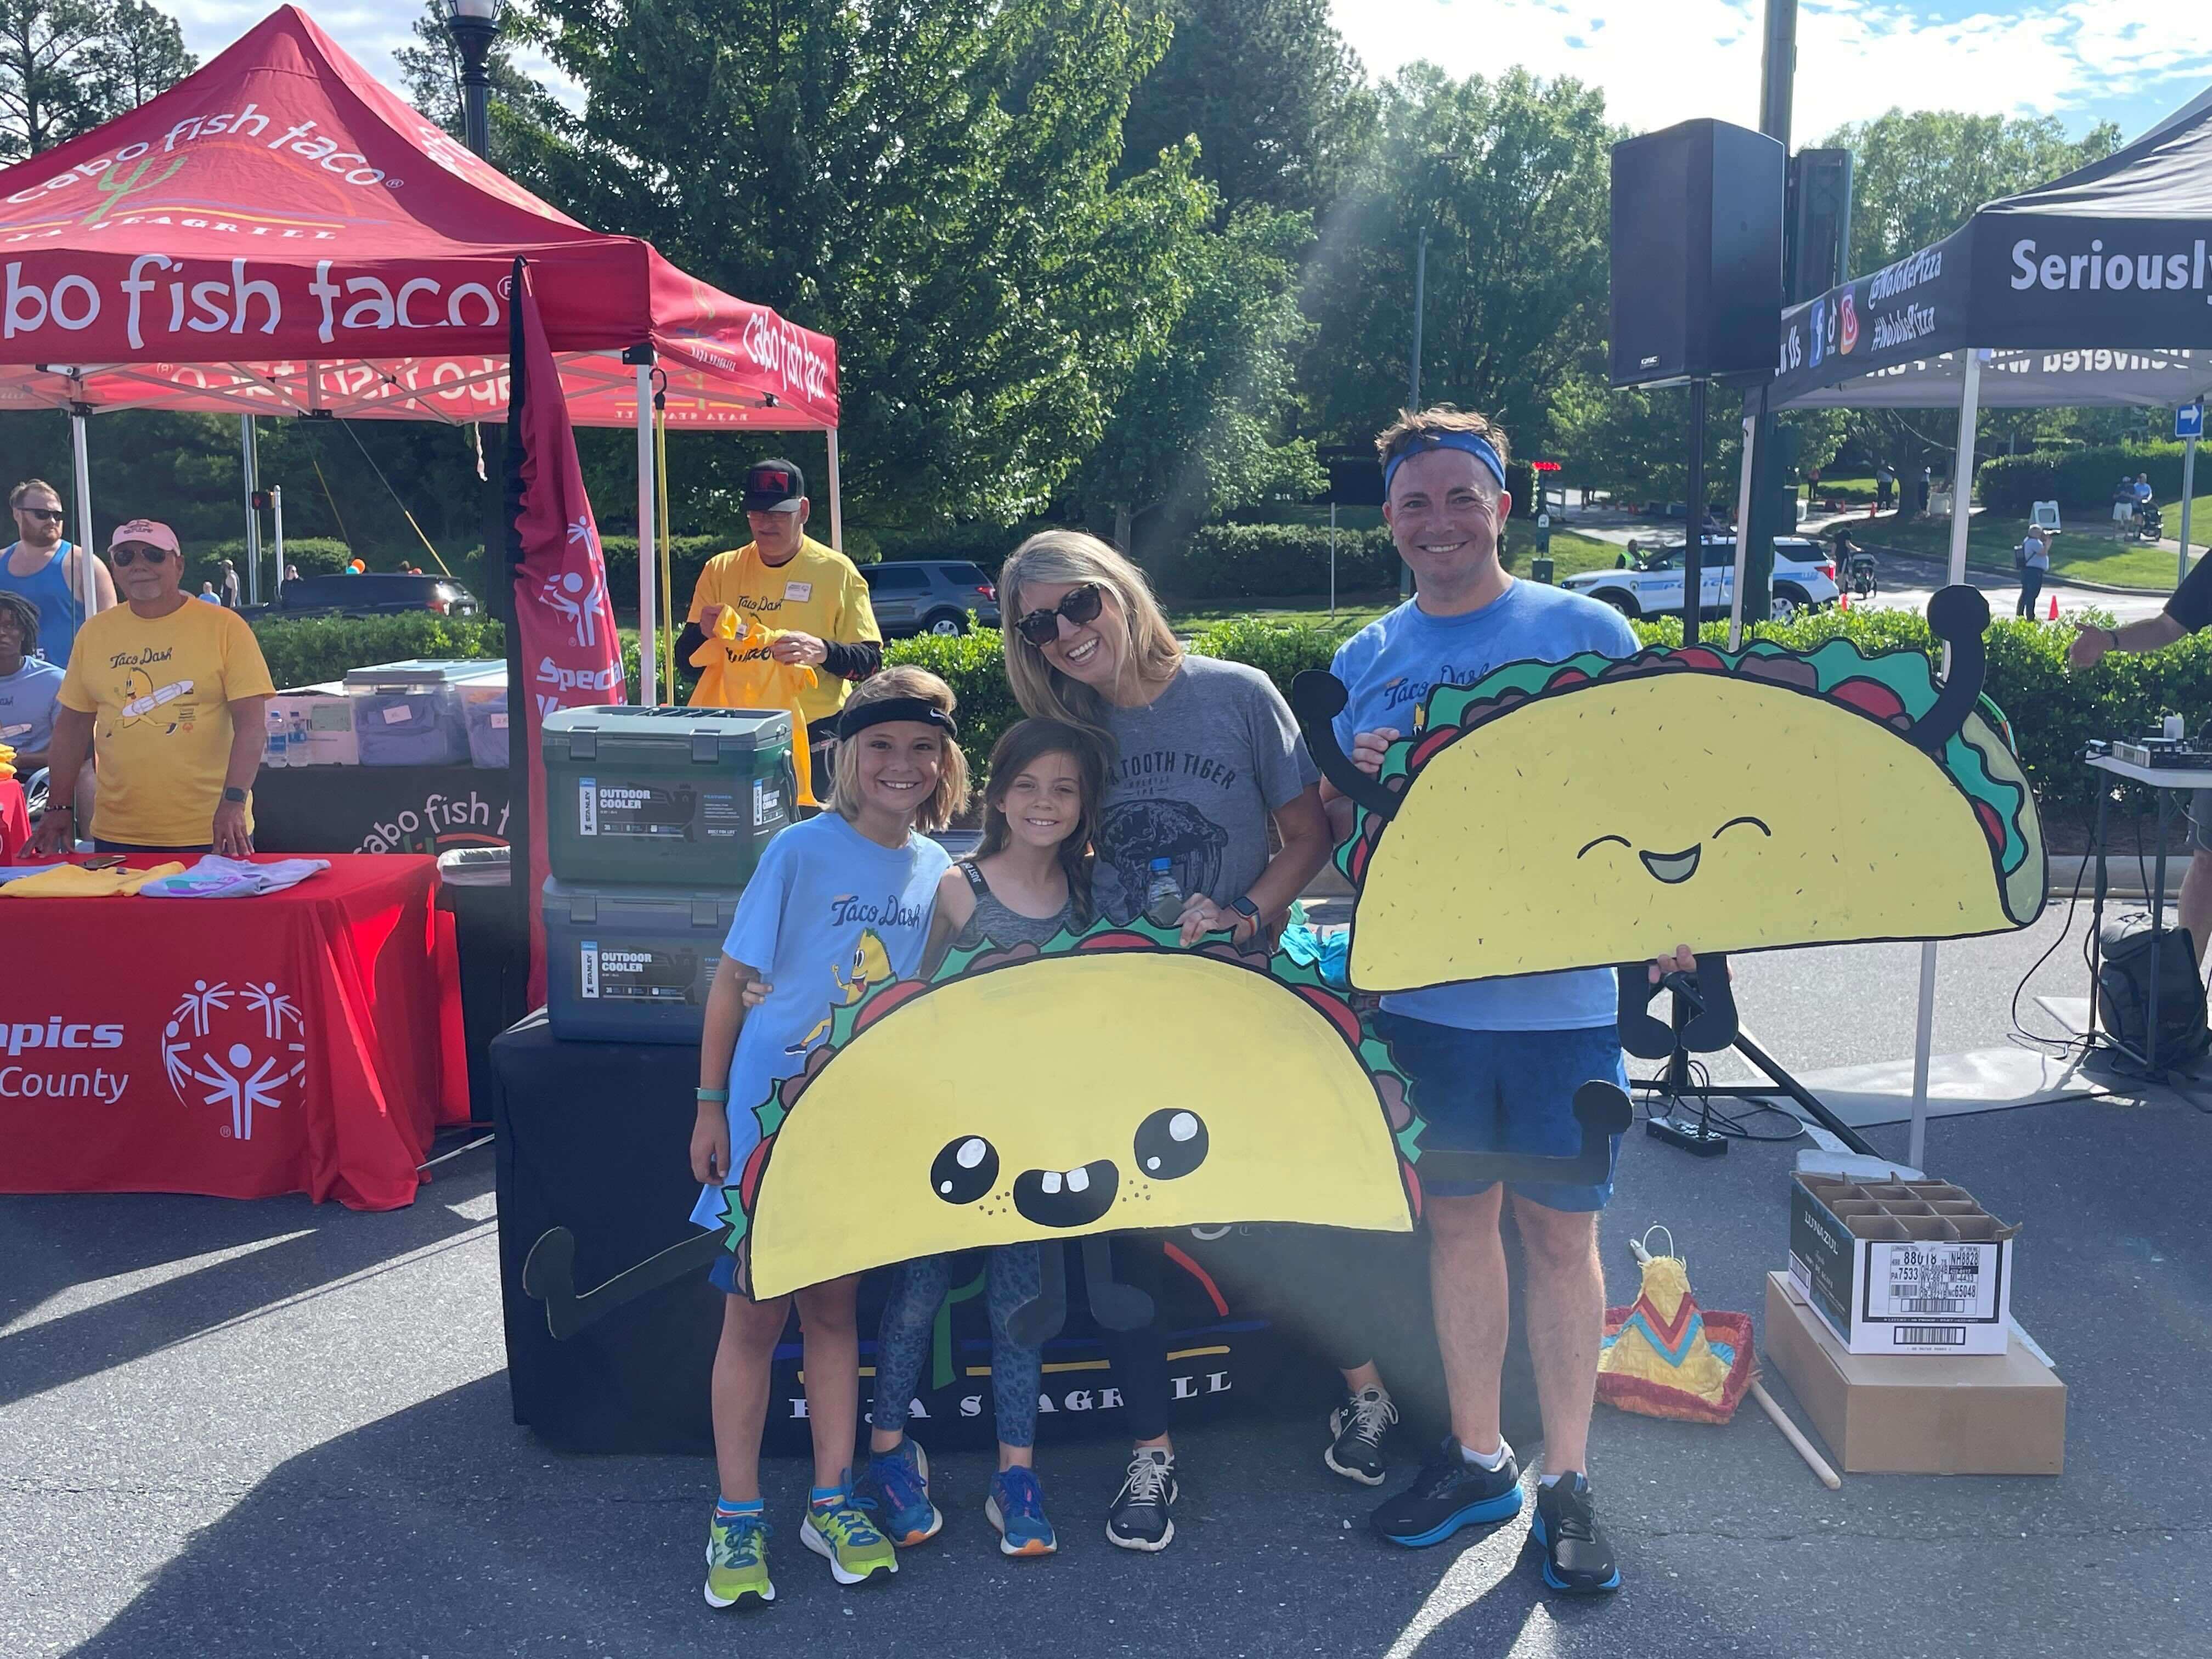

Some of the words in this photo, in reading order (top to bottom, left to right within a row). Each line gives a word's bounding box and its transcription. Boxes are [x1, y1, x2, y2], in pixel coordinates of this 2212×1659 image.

[165, 104, 269, 153] fish
[2011, 239, 2212, 305] Seriousl
[120, 253, 281, 349] fish
[1871, 302, 1935, 352] #NoJokePizza
[110, 652, 138, 669] Taco
[139, 646, 173, 665] Dash
[1384, 678, 1430, 711] Taco
[1121, 751, 1175, 778] TOOTH
[1183, 753, 1236, 790] TIGER
[600, 789, 651, 799] OUTDOOR
[600, 799, 641, 809] COOLER
[351, 811, 419, 855] abo
[424, 791, 489, 834] fish
[831, 895, 878, 927] Taco
[878, 894, 921, 930] Dash
[601, 952, 652, 962] OUTDOOR
[601, 962, 643, 973] COOLER
[0, 1015, 125, 1056] pics
[0, 1066, 129, 1104] County
[1804, 1210, 1838, 1256] LUNAZUL
[1899, 1267, 1918, 1280] 7533
[960, 1370, 1232, 1418] SAGRLL
